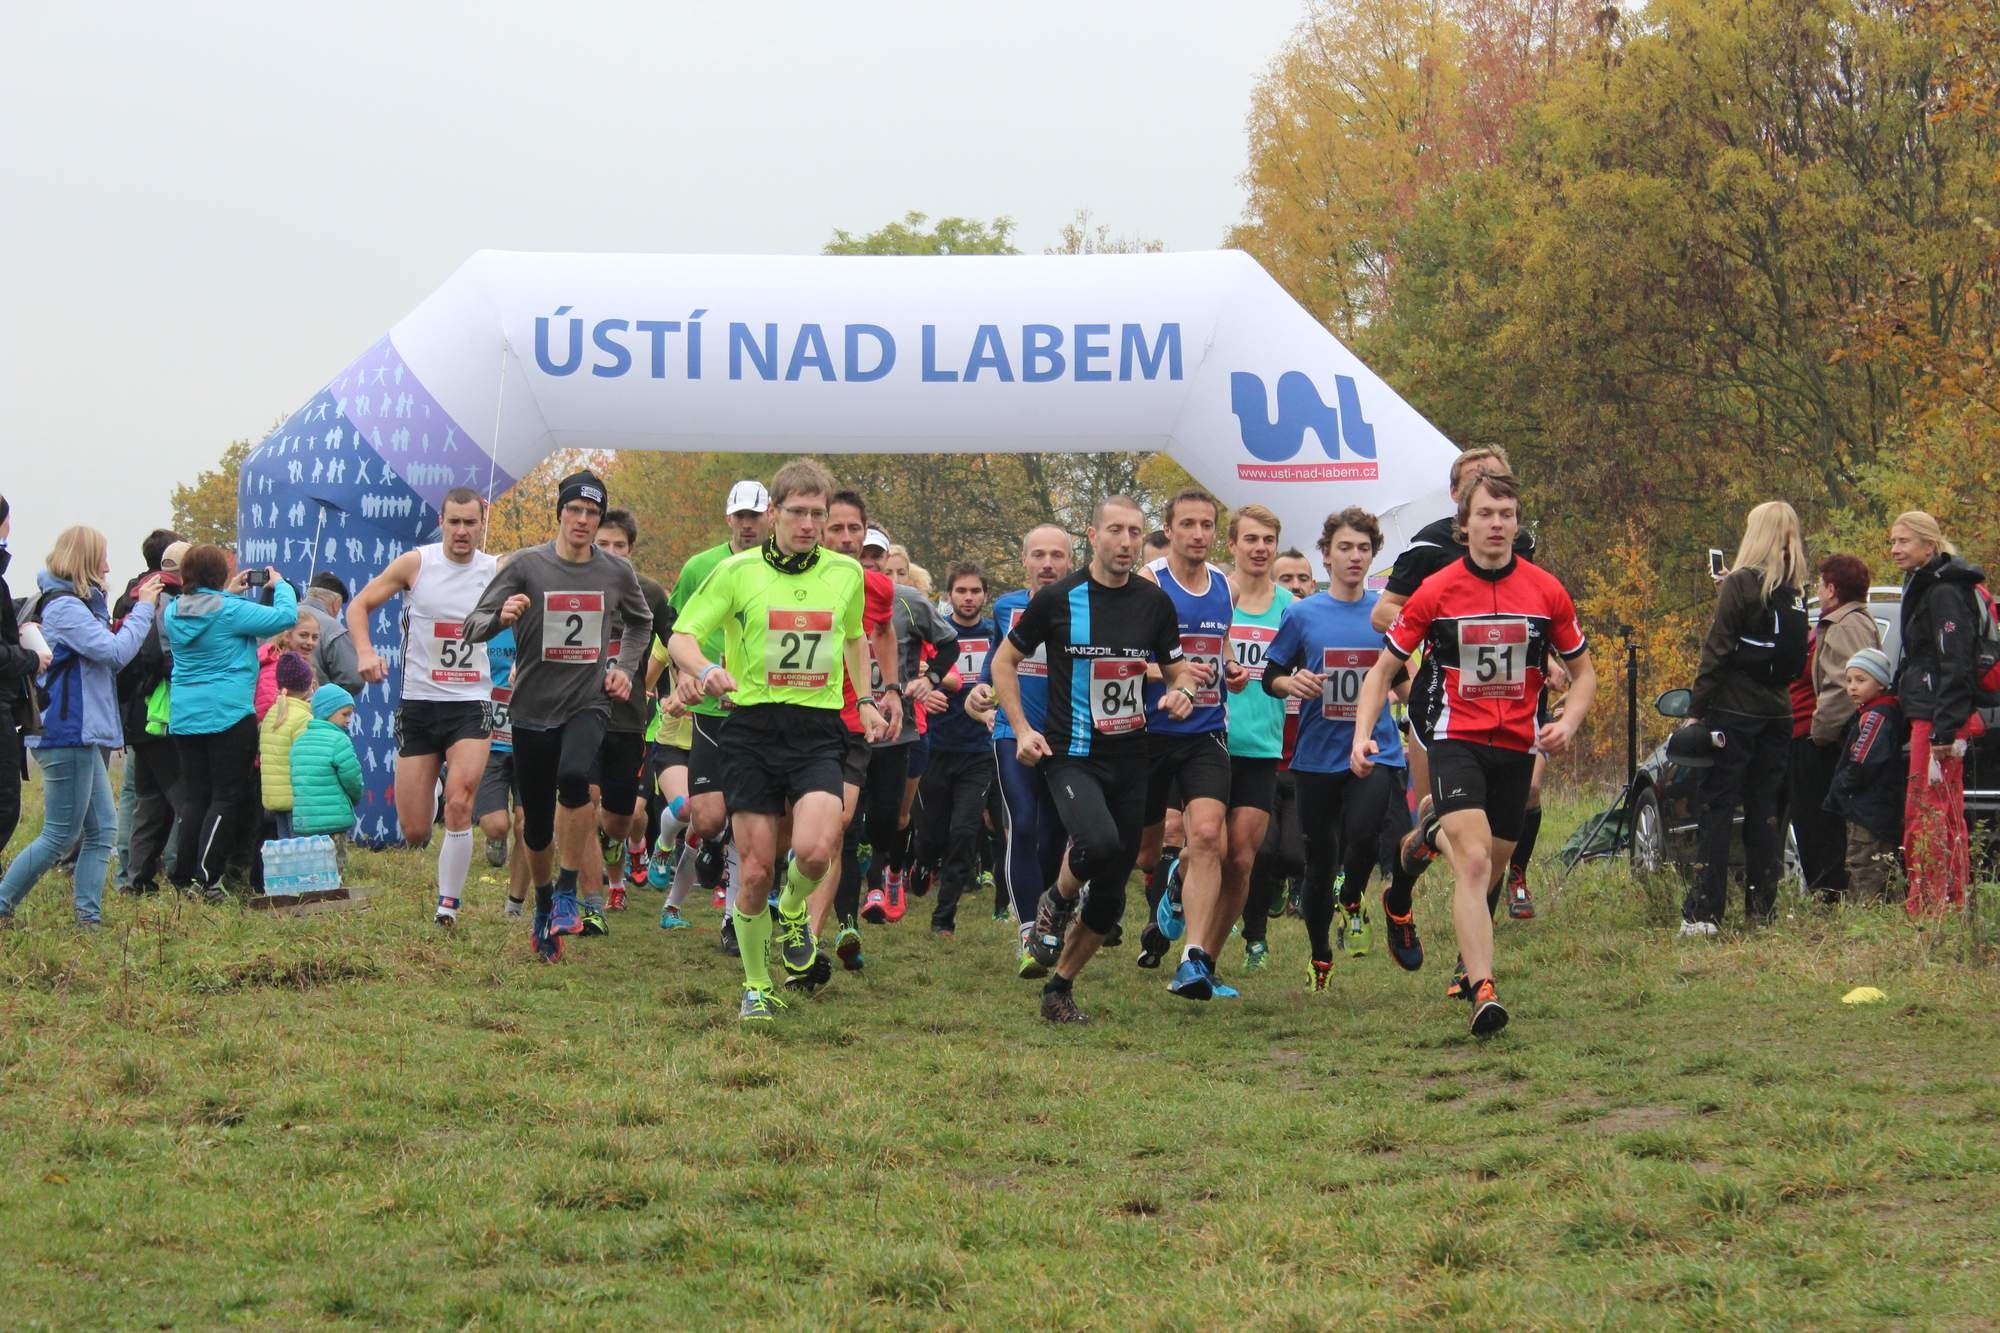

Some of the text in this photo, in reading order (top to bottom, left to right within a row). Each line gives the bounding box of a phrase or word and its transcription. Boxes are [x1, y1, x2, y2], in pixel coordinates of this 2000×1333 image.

[535, 305, 1184, 383] ÚSTÍ NAD LABEM
[1239, 467, 1377, 480] www.usti-nad-labem.cz
[564, 613, 583, 647] 2
[1200, 621, 1216, 629] ASK
[440, 639, 474, 668] 52
[779, 632, 822, 670] 27
[964, 654, 973, 672] 1
[1063, 645, 1117, 656] HNIZDIL
[1476, 645, 1513, 682] 51
[1102, 679, 1138, 716] 84
[1327, 669, 1369, 703] 10
[493, 702, 513, 729] 5
